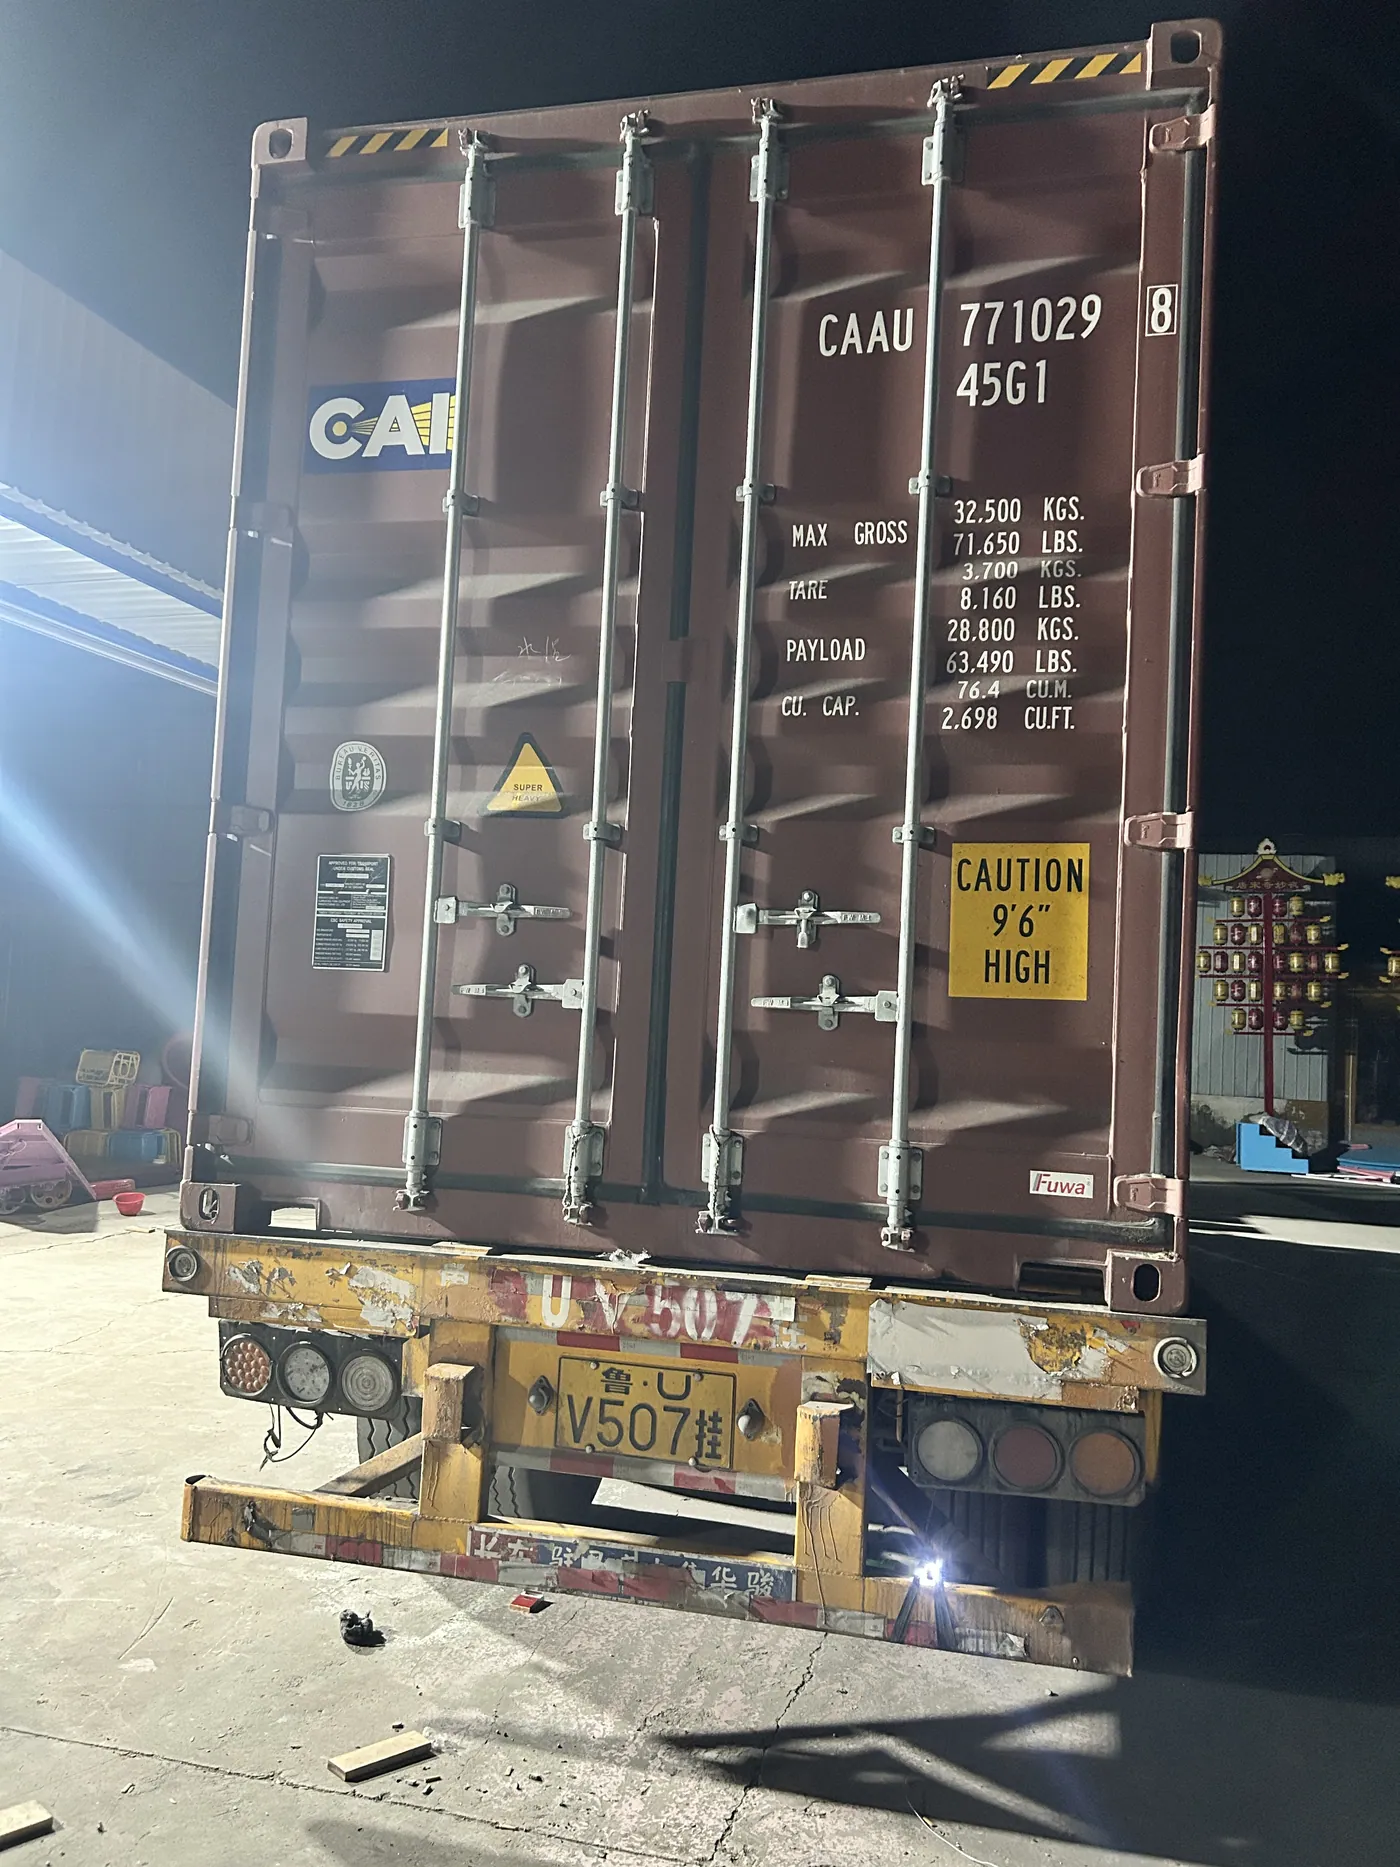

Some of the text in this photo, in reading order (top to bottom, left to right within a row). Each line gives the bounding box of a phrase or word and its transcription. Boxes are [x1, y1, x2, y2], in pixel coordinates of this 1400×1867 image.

[819, 287, 1172, 357] CAAU 771029 8
[956, 359, 1047, 407] 45G1
[309, 393, 450, 460] CAI
[1043, 496, 1085, 522] KGS.
[792, 520, 908, 548] MAX GROSS
[1041, 530, 1083, 555] LBS.
[1040, 559, 1082, 579] KGS.
[788, 579, 829, 600] TARE
[1038, 585, 1081, 609] LBS.
[1037, 617, 1079, 641] KGS.
[786, 637, 866, 662] PAYLOAD
[1035, 649, 1077, 674] LBS.
[957, 680, 1000, 700] 76.4
[781, 695, 860, 717] CU. CAP.
[513, 783, 543, 792] SUPER
[957, 858, 1084, 893] CAUTION
[984, 950, 1050, 985] HIGH
[1032, 1173, 1086, 1195] Fuwa
[567, 1394, 723, 1460] V507挂
